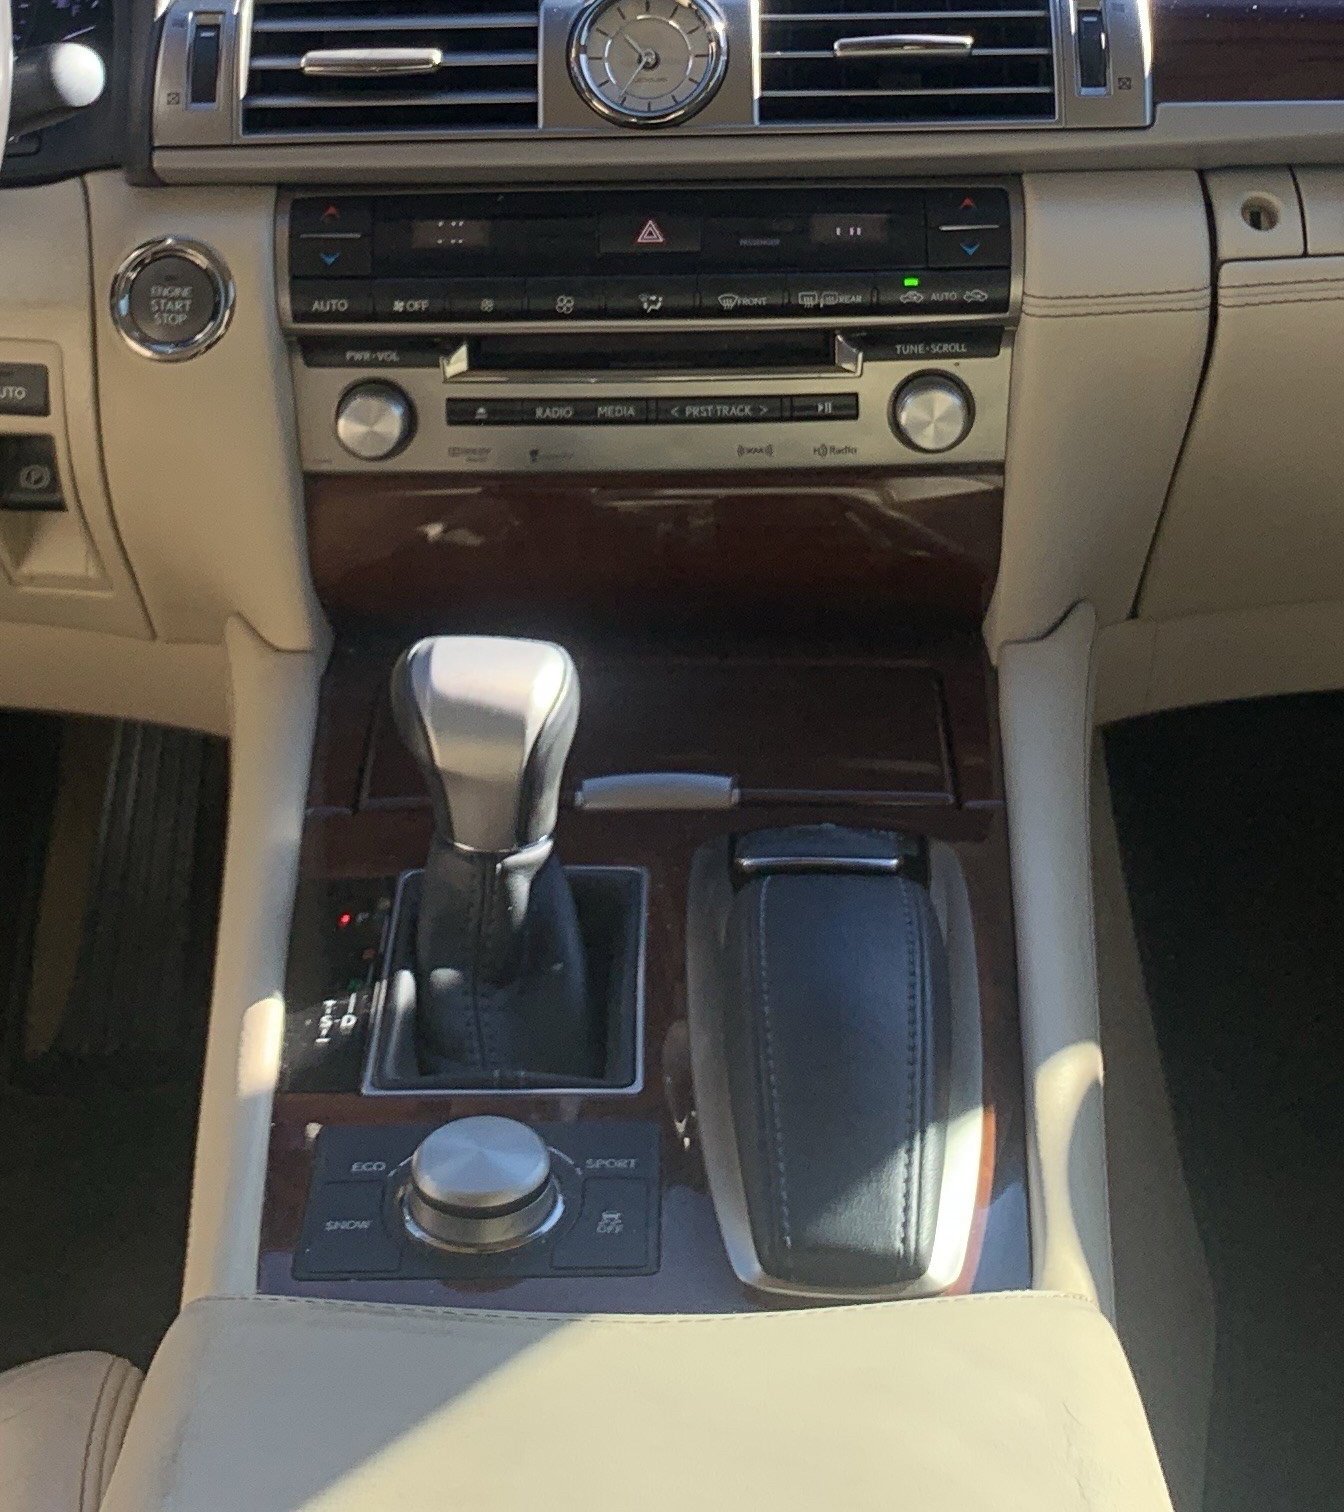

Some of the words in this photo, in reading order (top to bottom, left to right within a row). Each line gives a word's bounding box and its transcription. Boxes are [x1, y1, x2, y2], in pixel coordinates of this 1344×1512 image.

[737, 295, 768, 306] FRONT
[930, 290, 958, 302] AUTO
[150, 298, 193, 312] START
[311, 298, 349, 313] AUTO
[405, 298, 430, 312] OFF
[154, 311, 188, 326] STOP
[535, 405, 574, 419] RADIO
[596, 405, 636, 418] MEDIA
[351, 1161, 386, 1172] ECO
[585, 1158, 638, 1170] SPORT
[325, 1219, 373, 1231] SNOW
